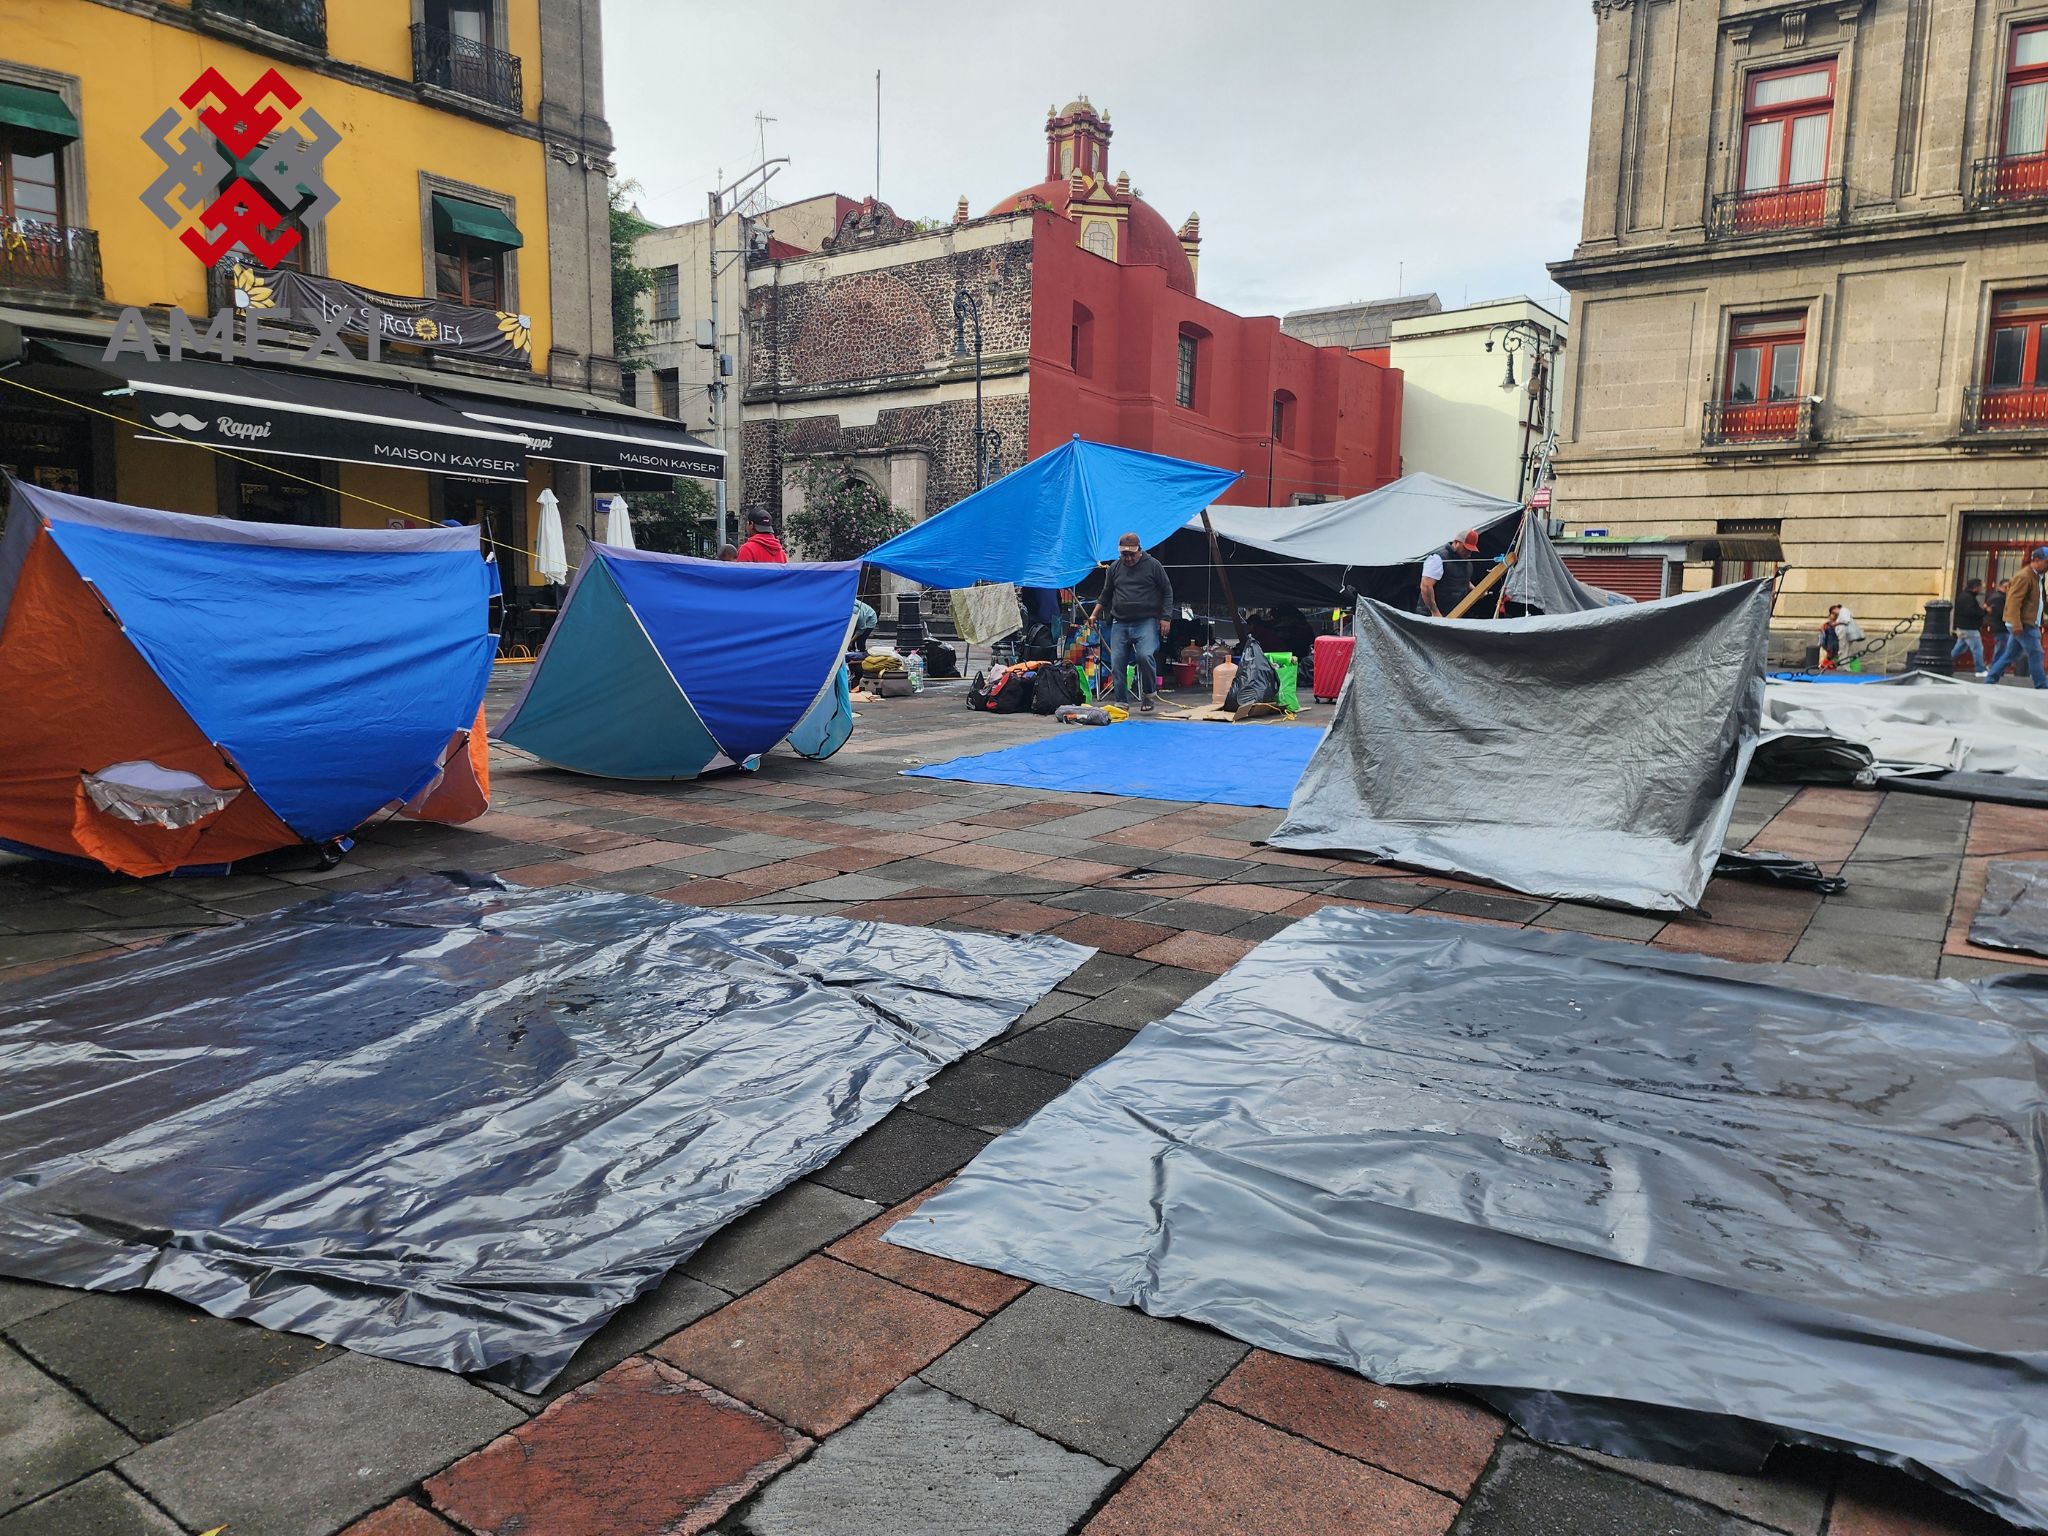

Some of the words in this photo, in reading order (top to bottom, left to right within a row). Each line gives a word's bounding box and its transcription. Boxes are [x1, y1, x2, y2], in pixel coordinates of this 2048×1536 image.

[216, 416, 272, 441] Rappi
[374, 444, 446, 464] MAISON
[619, 452, 668, 467] MAISON
[467, 477, 490, 485] PARIS
